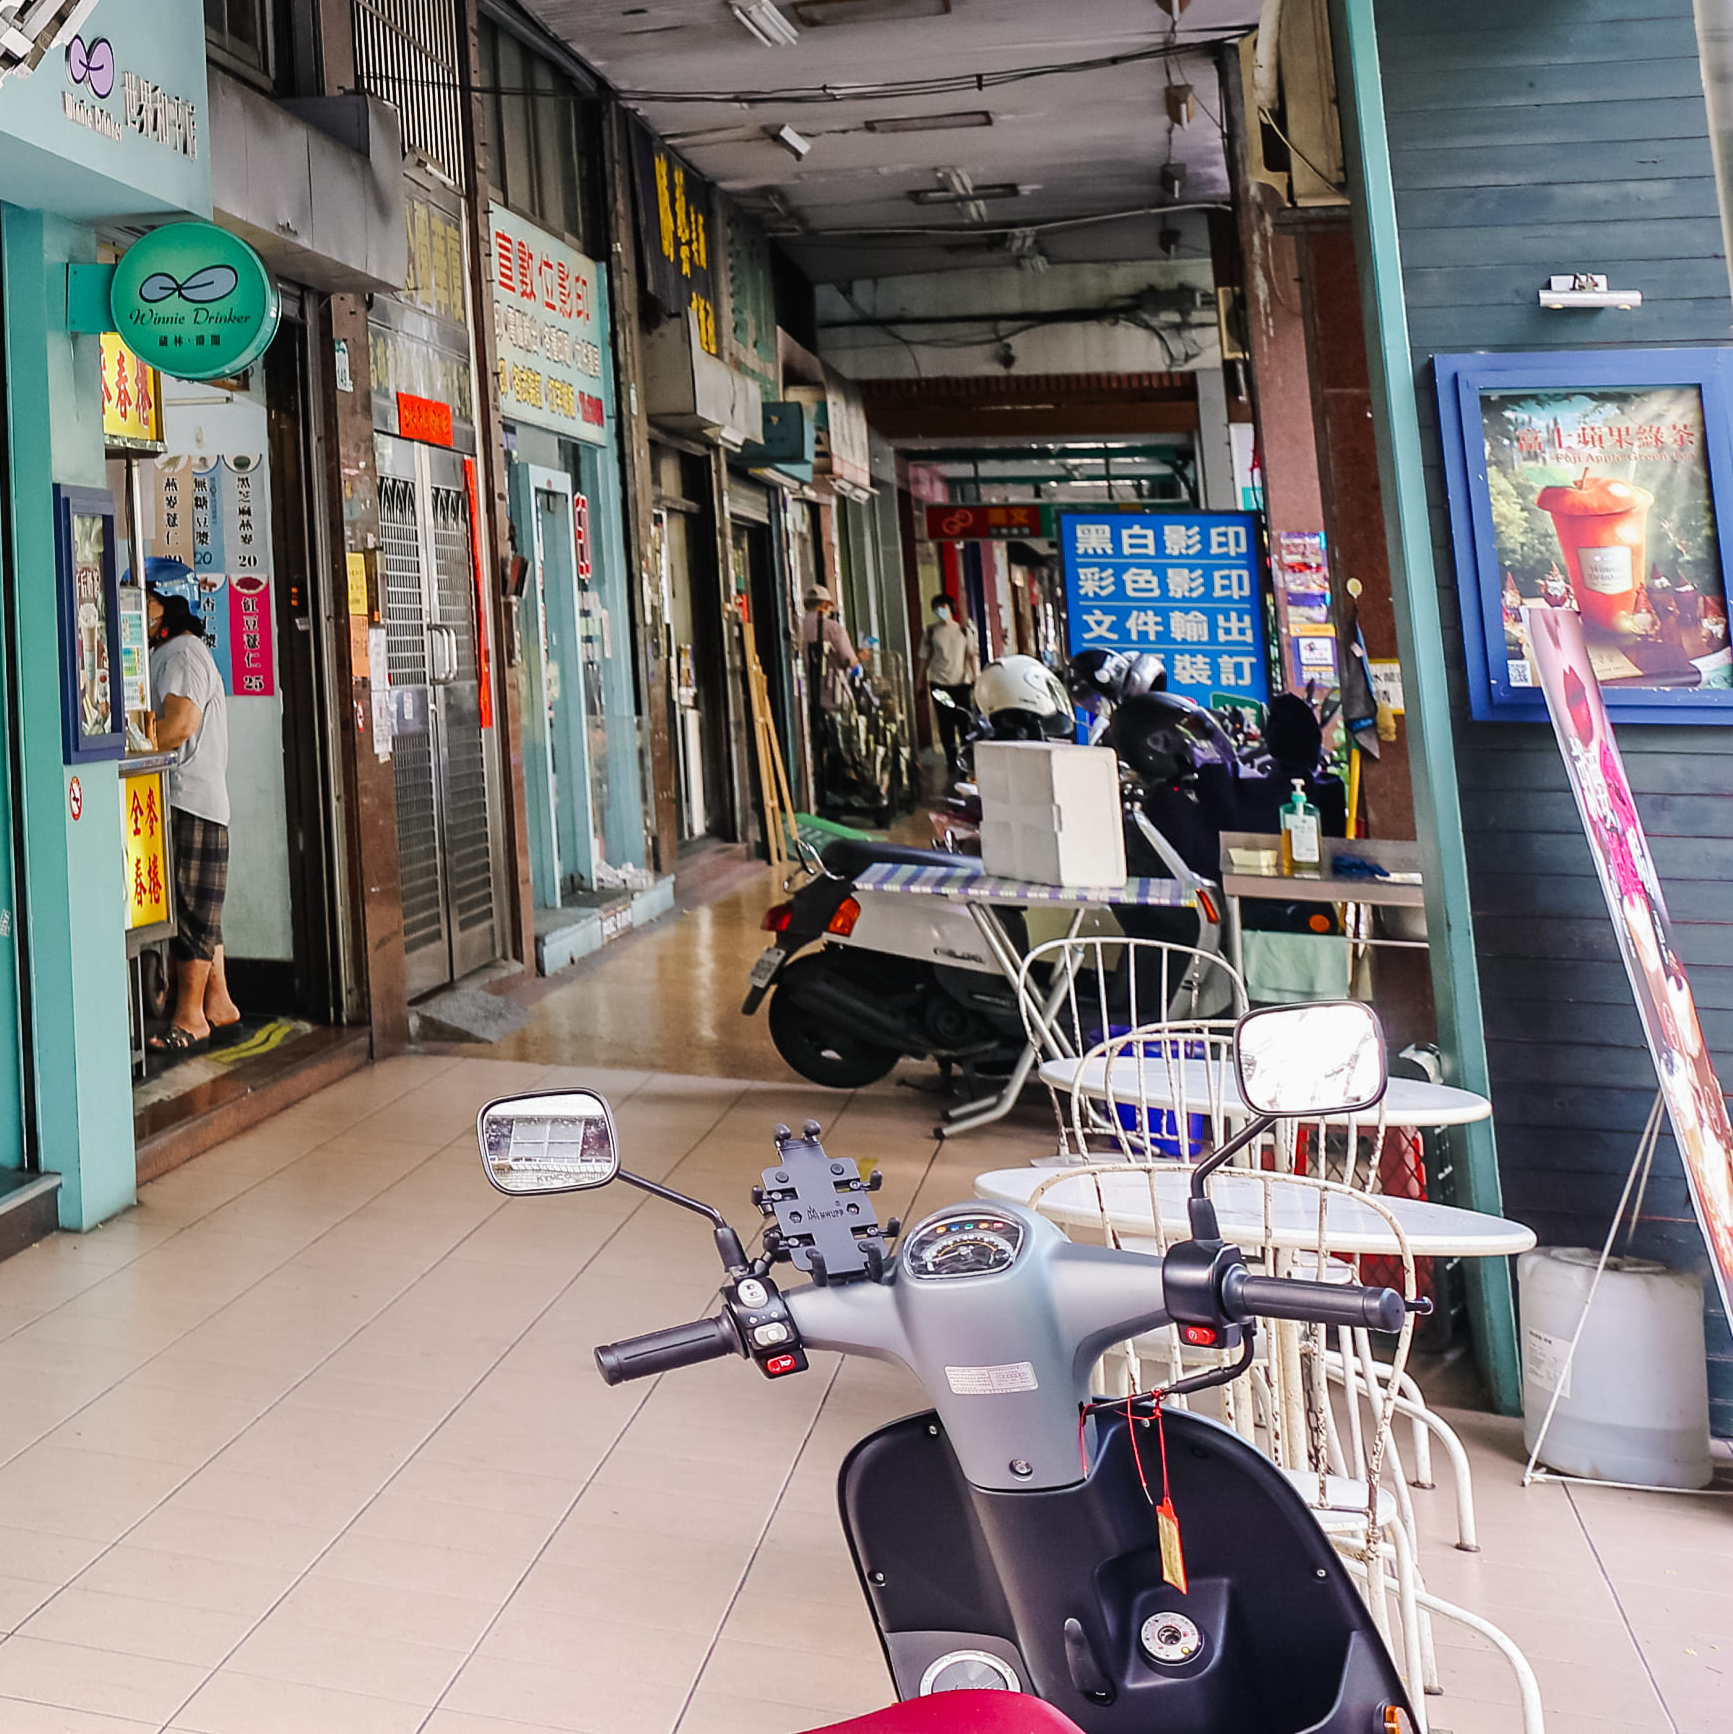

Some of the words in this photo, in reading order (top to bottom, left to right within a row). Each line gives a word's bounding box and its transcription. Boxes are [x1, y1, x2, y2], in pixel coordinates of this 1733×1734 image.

[129, 308, 185, 326] Winnie
[193, 307, 251, 325] Drinker
[1556, 453, 1582, 465] Fuji
[1586, 453, 1623, 463] Apple
[1075, 524, 1248, 557] 黑白影印
[238, 554, 258, 568] 20
[1077, 567, 1251, 600] 彩色影印
[1082, 609, 1254, 644] 文件輸出
[243, 676, 265, 691] 25
[537, 1174, 572, 1183] KYMCO
